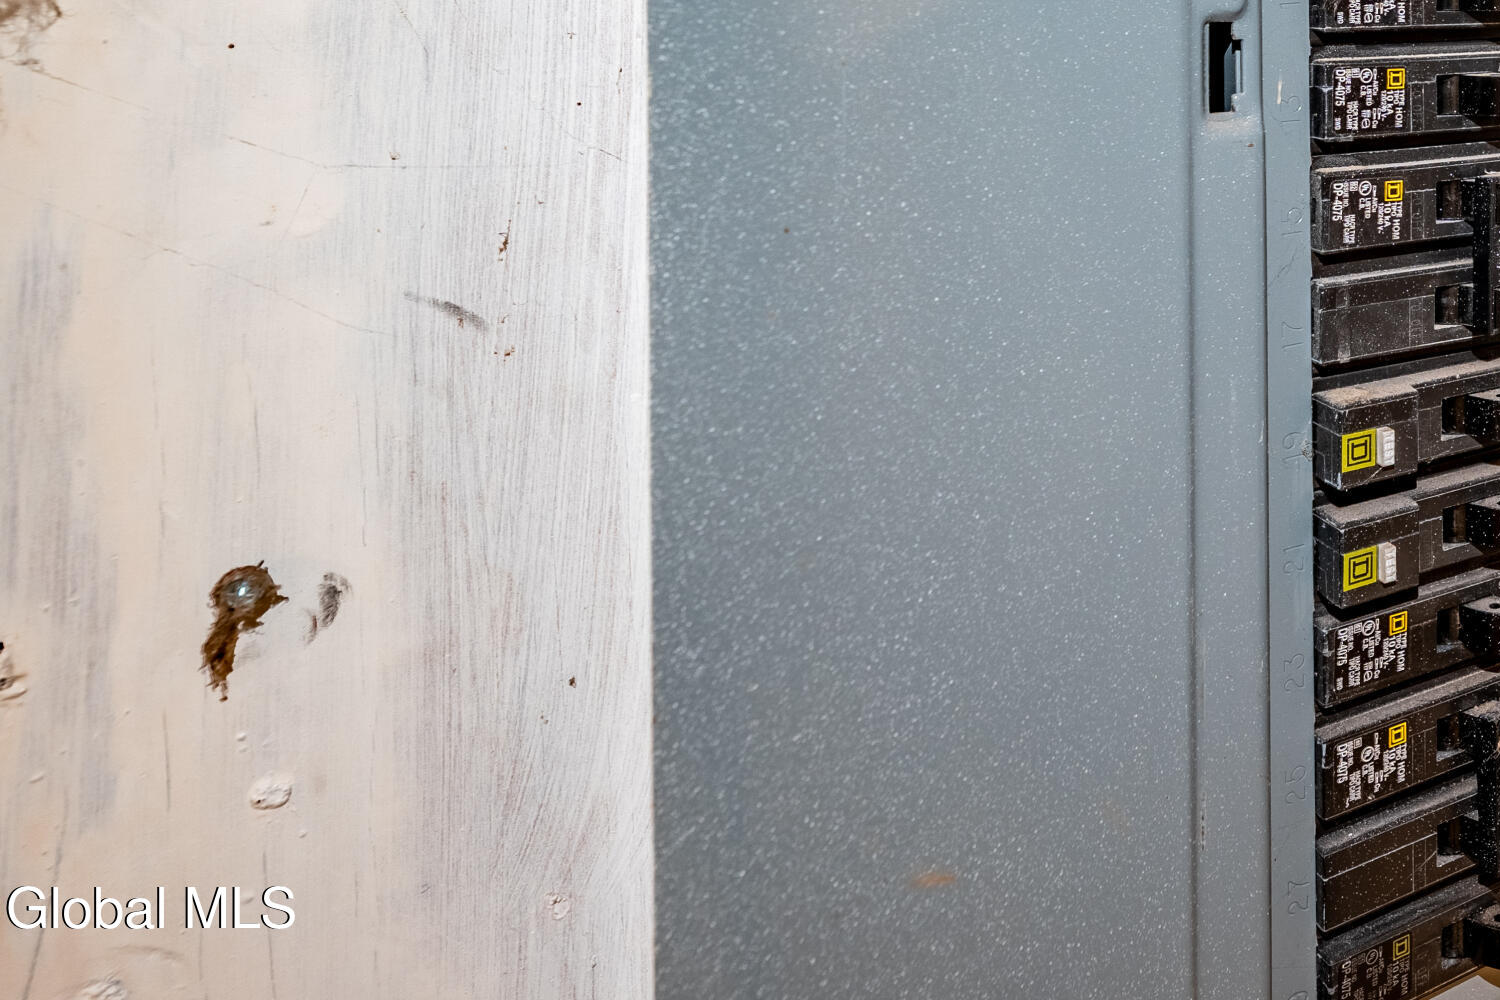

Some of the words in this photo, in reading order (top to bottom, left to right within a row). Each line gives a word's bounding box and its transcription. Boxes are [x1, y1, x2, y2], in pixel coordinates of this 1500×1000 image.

[1397, 2, 1405, 22] HOM
[1335, 69, 1345, 106] DP-4075
[1332, 183, 1342, 221] DP-4075
